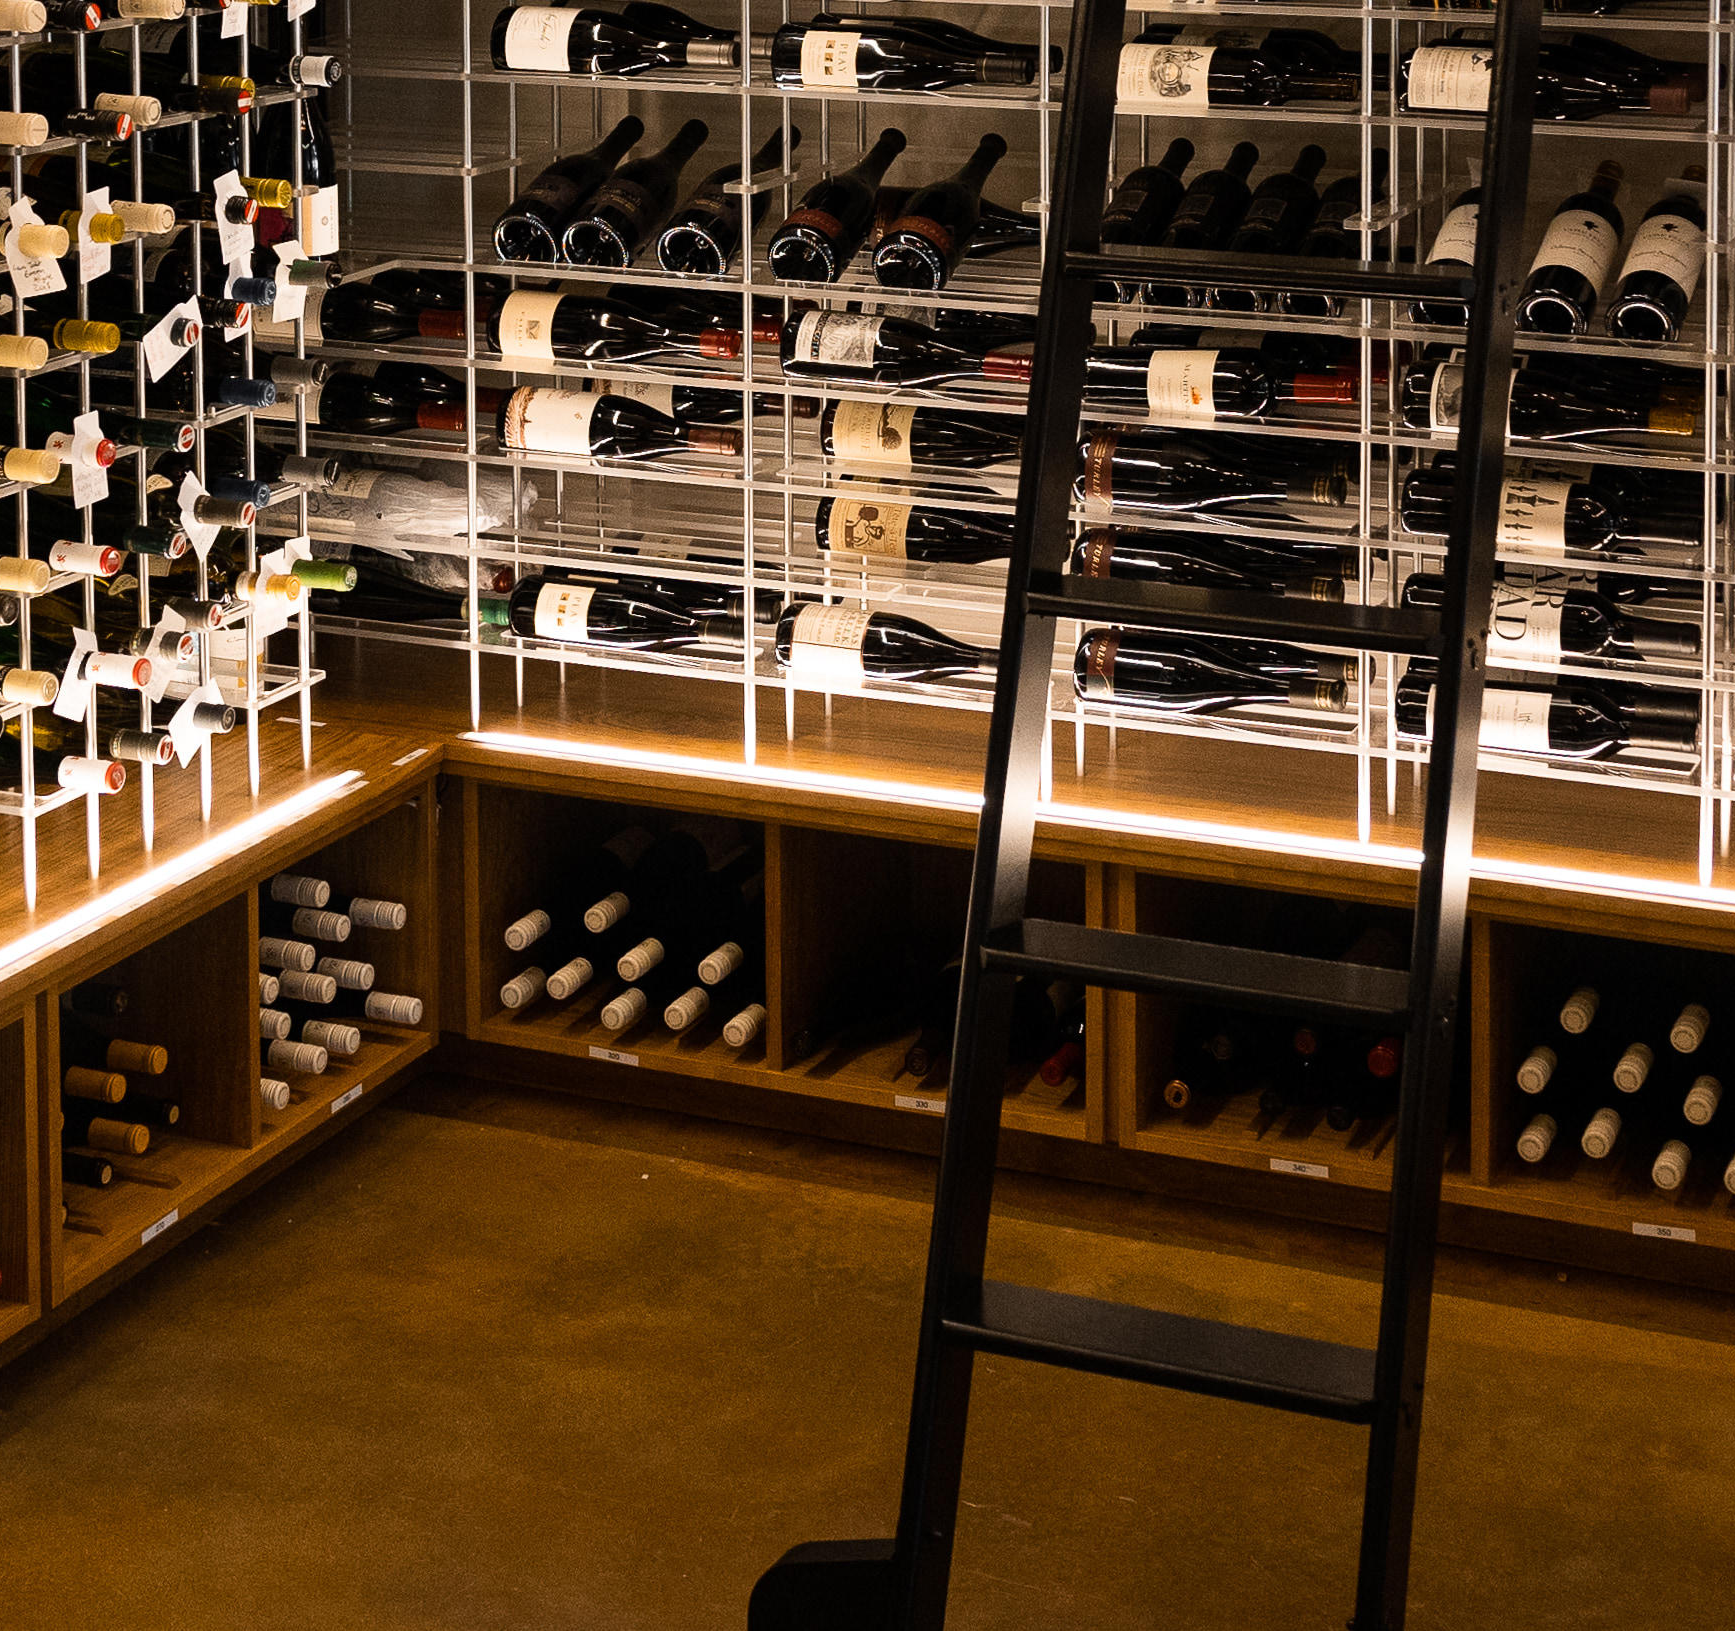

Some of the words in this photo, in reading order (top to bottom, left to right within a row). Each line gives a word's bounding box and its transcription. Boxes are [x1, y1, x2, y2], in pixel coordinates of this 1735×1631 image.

[838, 43, 849, 74] PEAY
[1091, 457, 1104, 497] TURLEY
[1090, 543, 1104, 578] TURLE
[1292, 1164, 1307, 1173] 340
[1657, 1227, 1672, 1237] 350
